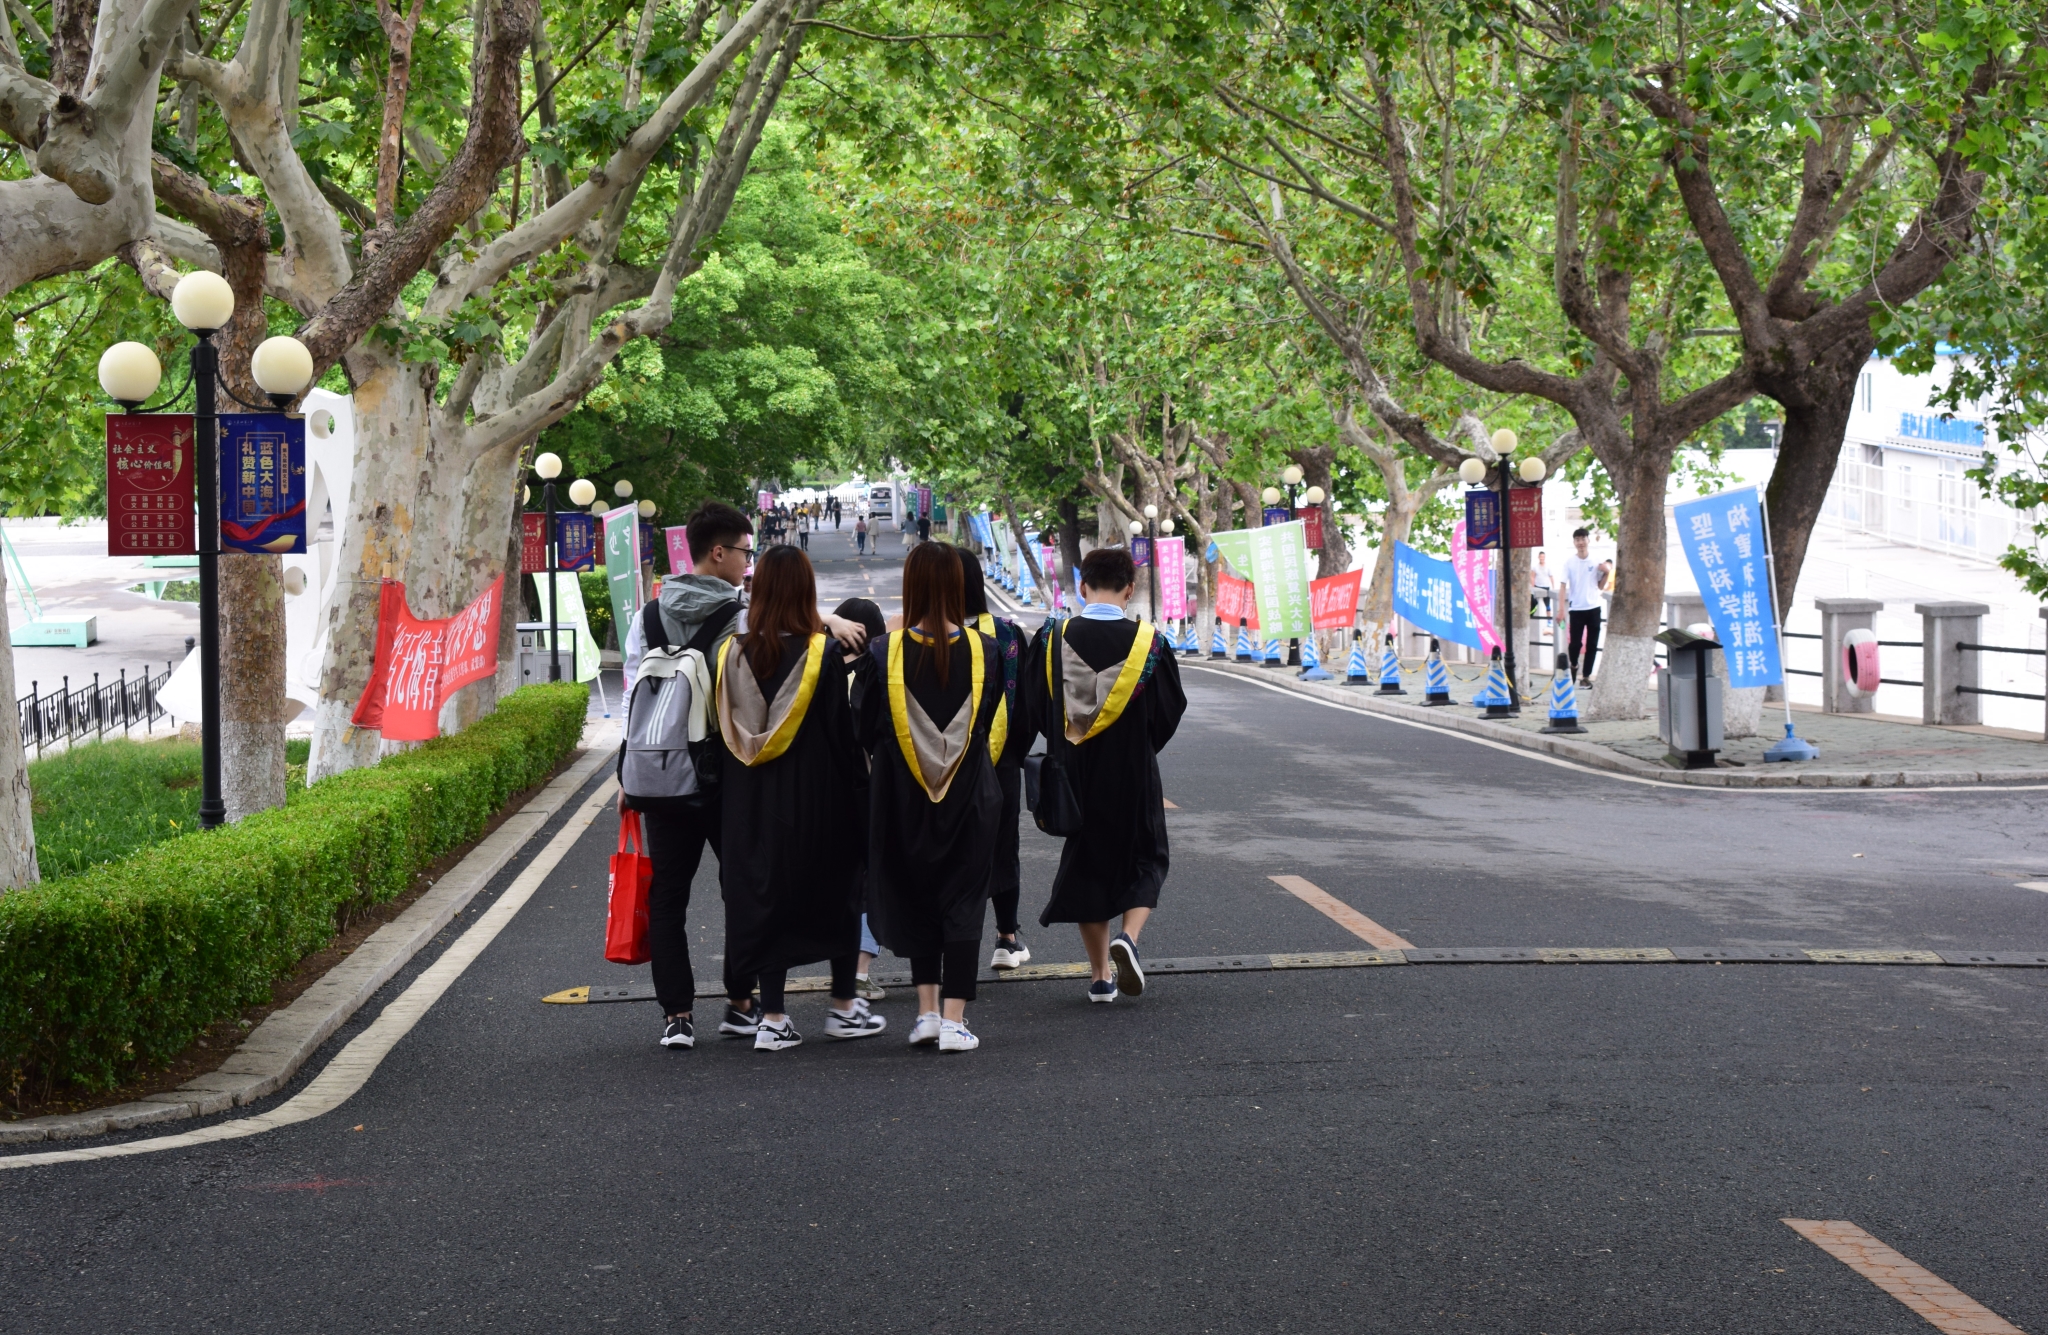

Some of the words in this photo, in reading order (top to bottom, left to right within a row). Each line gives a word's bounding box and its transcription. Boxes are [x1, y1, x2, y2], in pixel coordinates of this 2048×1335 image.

[112, 444, 157, 454] 社会主义
[117, 457, 173, 470] 核心价值观
[242, 442, 256, 513] 礼赞新中国
[260, 442, 273, 513] 蓝色大海大
